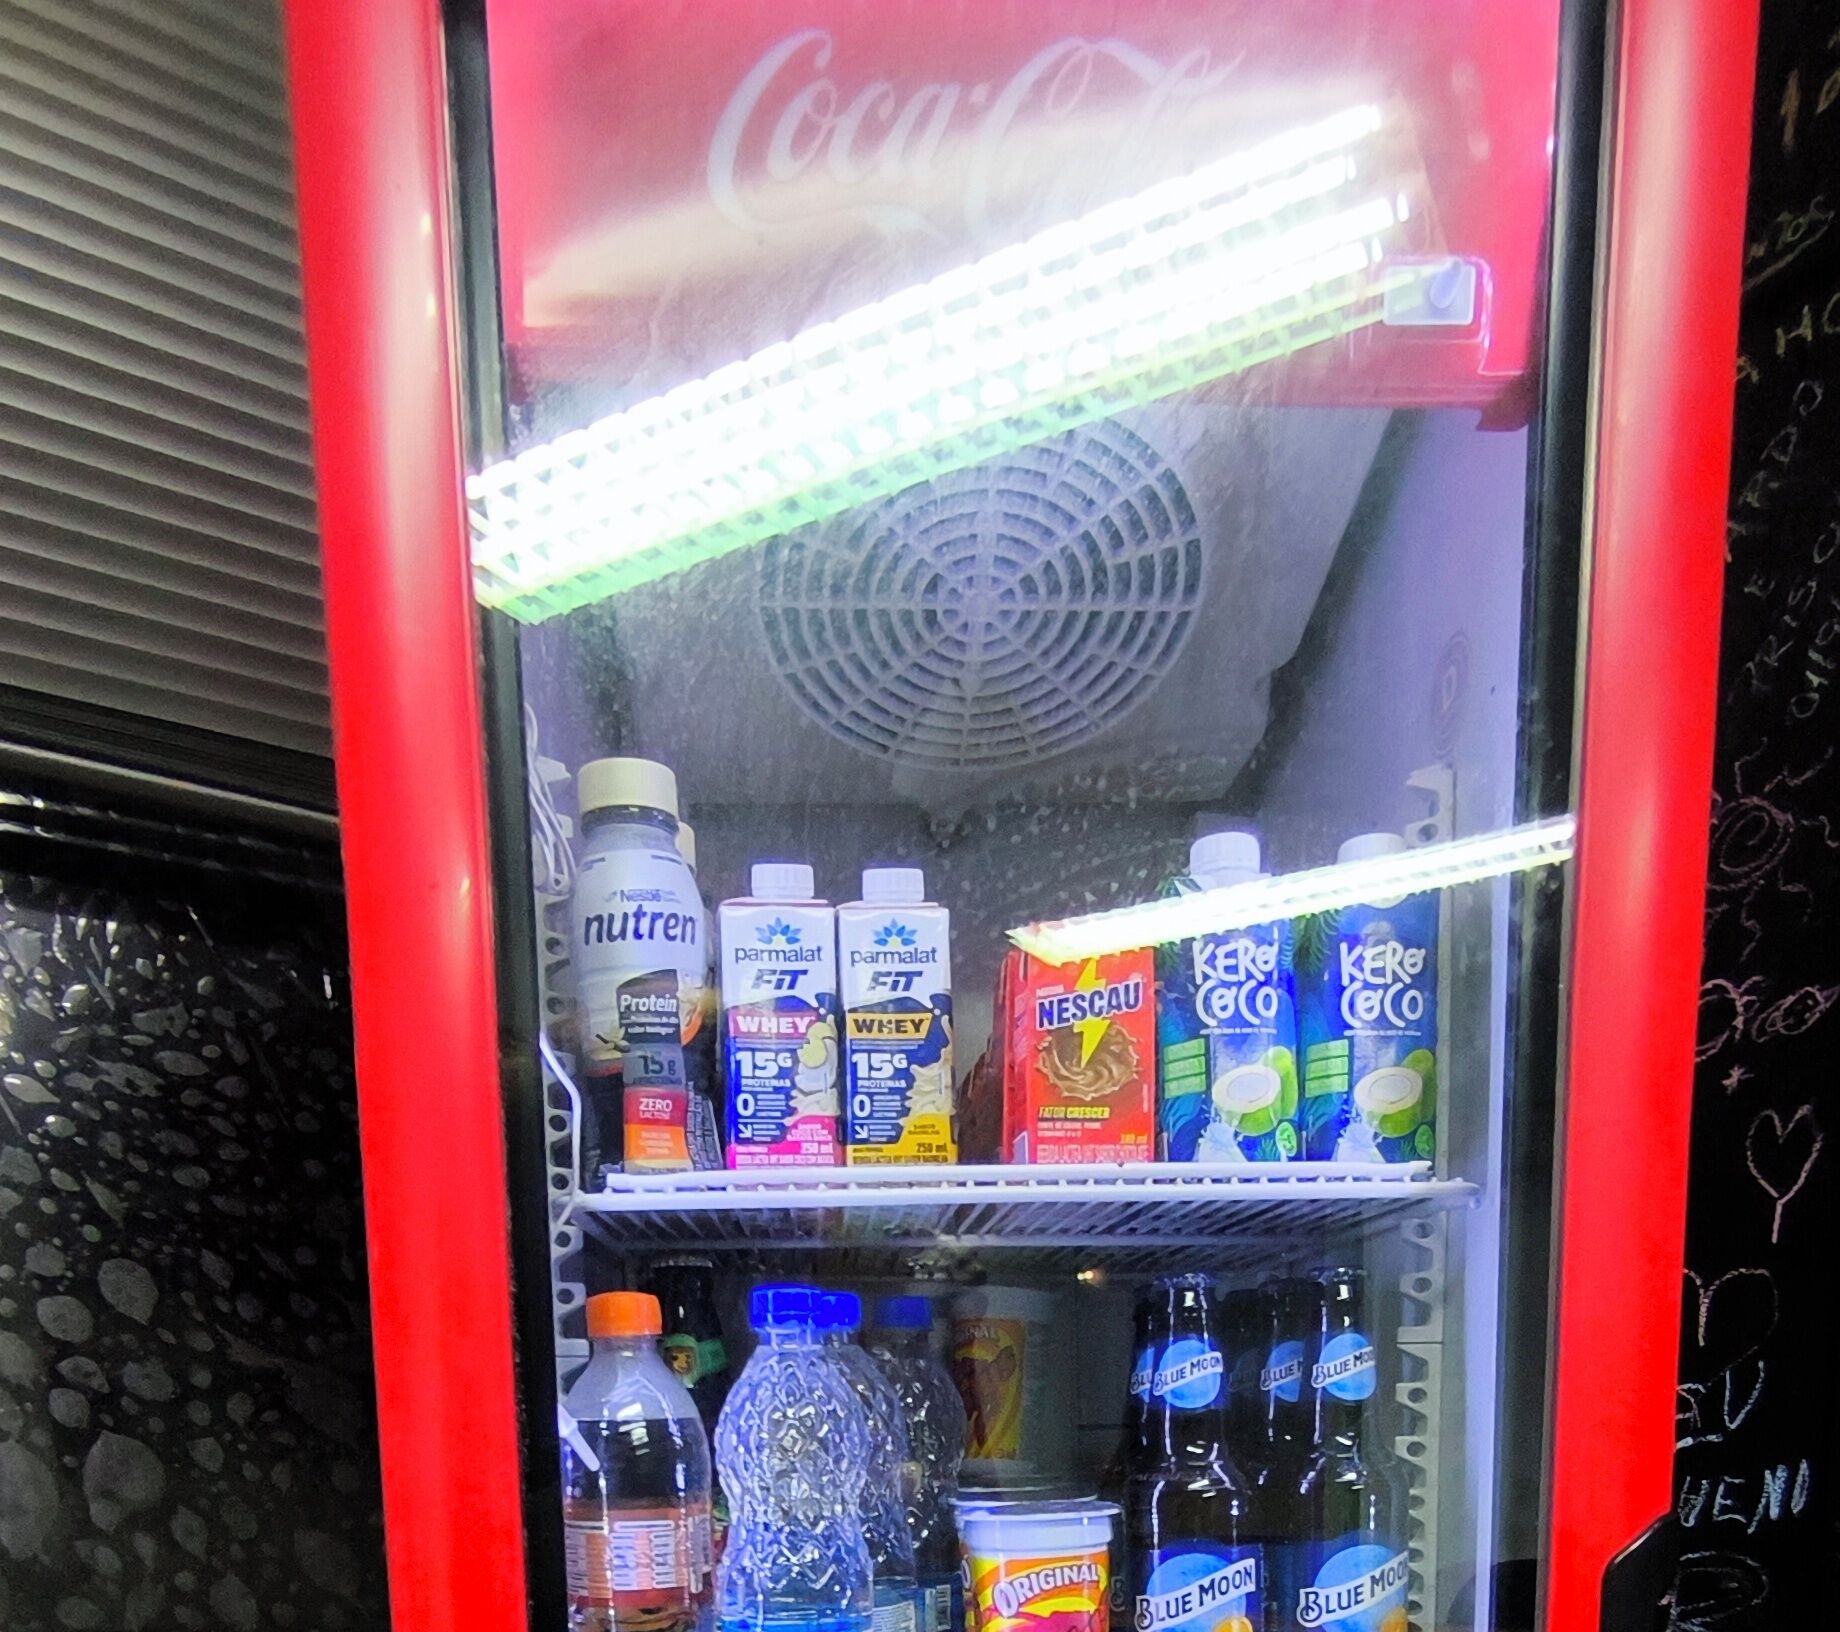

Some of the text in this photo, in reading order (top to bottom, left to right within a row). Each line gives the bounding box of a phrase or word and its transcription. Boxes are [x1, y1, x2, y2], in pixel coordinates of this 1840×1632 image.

[584, 905, 696, 946] nutren
[734, 945, 823, 964] parmalat
[850, 947, 937, 967] parmalat
[620, 993, 678, 1012] Protein
[1038, 981, 1141, 1029] NESCAU
[736, 1015, 809, 1034] WHEY
[853, 1018, 924, 1035] WHEY
[639, 1098, 672, 1111] ZERO
[1155, 1354, 1221, 1393] BLUE MOON
[1314, 1361, 1349, 1385] BLUE
[993, 1563, 1099, 1617] ORIGINAL
[1139, 1565, 1253, 1631] BLUE MOON
[1300, 1582, 1365, 1623] BLUE
